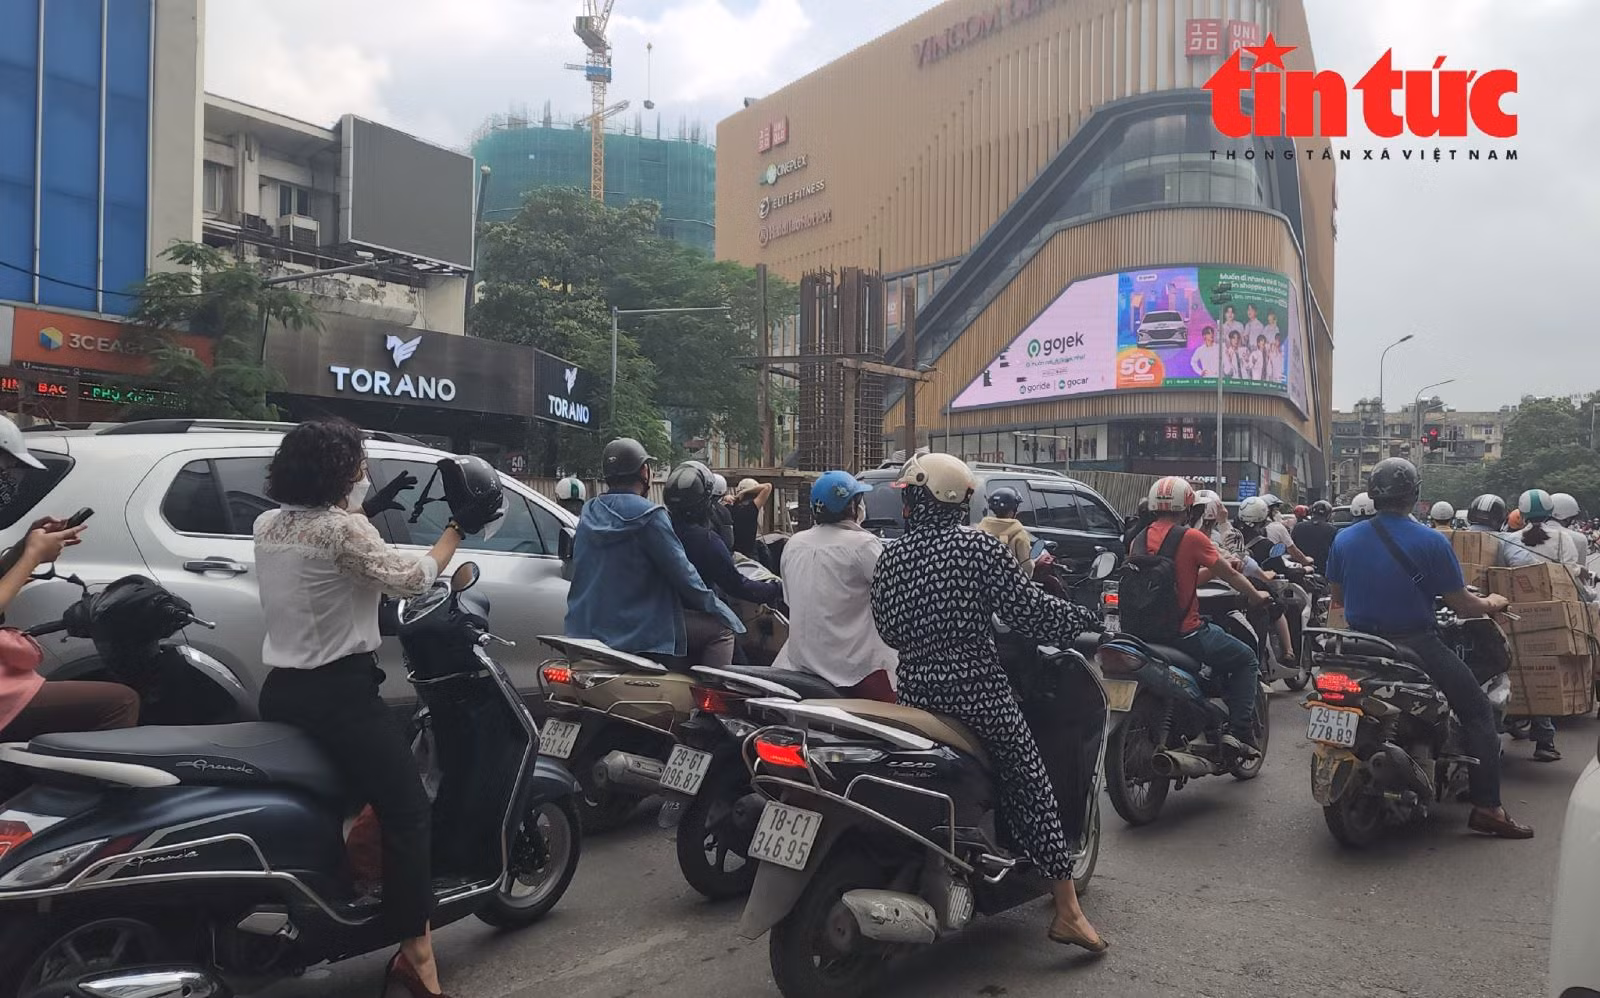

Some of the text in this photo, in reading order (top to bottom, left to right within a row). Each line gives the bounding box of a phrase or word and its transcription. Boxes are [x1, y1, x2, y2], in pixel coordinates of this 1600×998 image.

[912, 10, 1001, 68] VINCOM
[1233, 24, 1256, 40] UNI
[777, 154, 808, 176] CINEPLEX
[772, 180, 826, 209] ELITE FITNESS
[1043, 331, 1084, 356] gojek
[329, 365, 456, 401] TORANO
[1027, 377, 1089, 394] goride gocar
[547, 394, 590, 424] TORANO
[545, 721, 575, 735] 29-X7
[1315, 707, 1351, 728] 29-E1
[1309, 722, 1353, 744] 778.89
[176, 759, 255, 775] Grande
[671, 748, 704, 771] 29-G1
[661, 767, 701, 792] 096.87
[768, 807, 812, 839] 18-C1
[125, 849, 200, 869] Grande
[752, 831, 809, 865] 346.95
